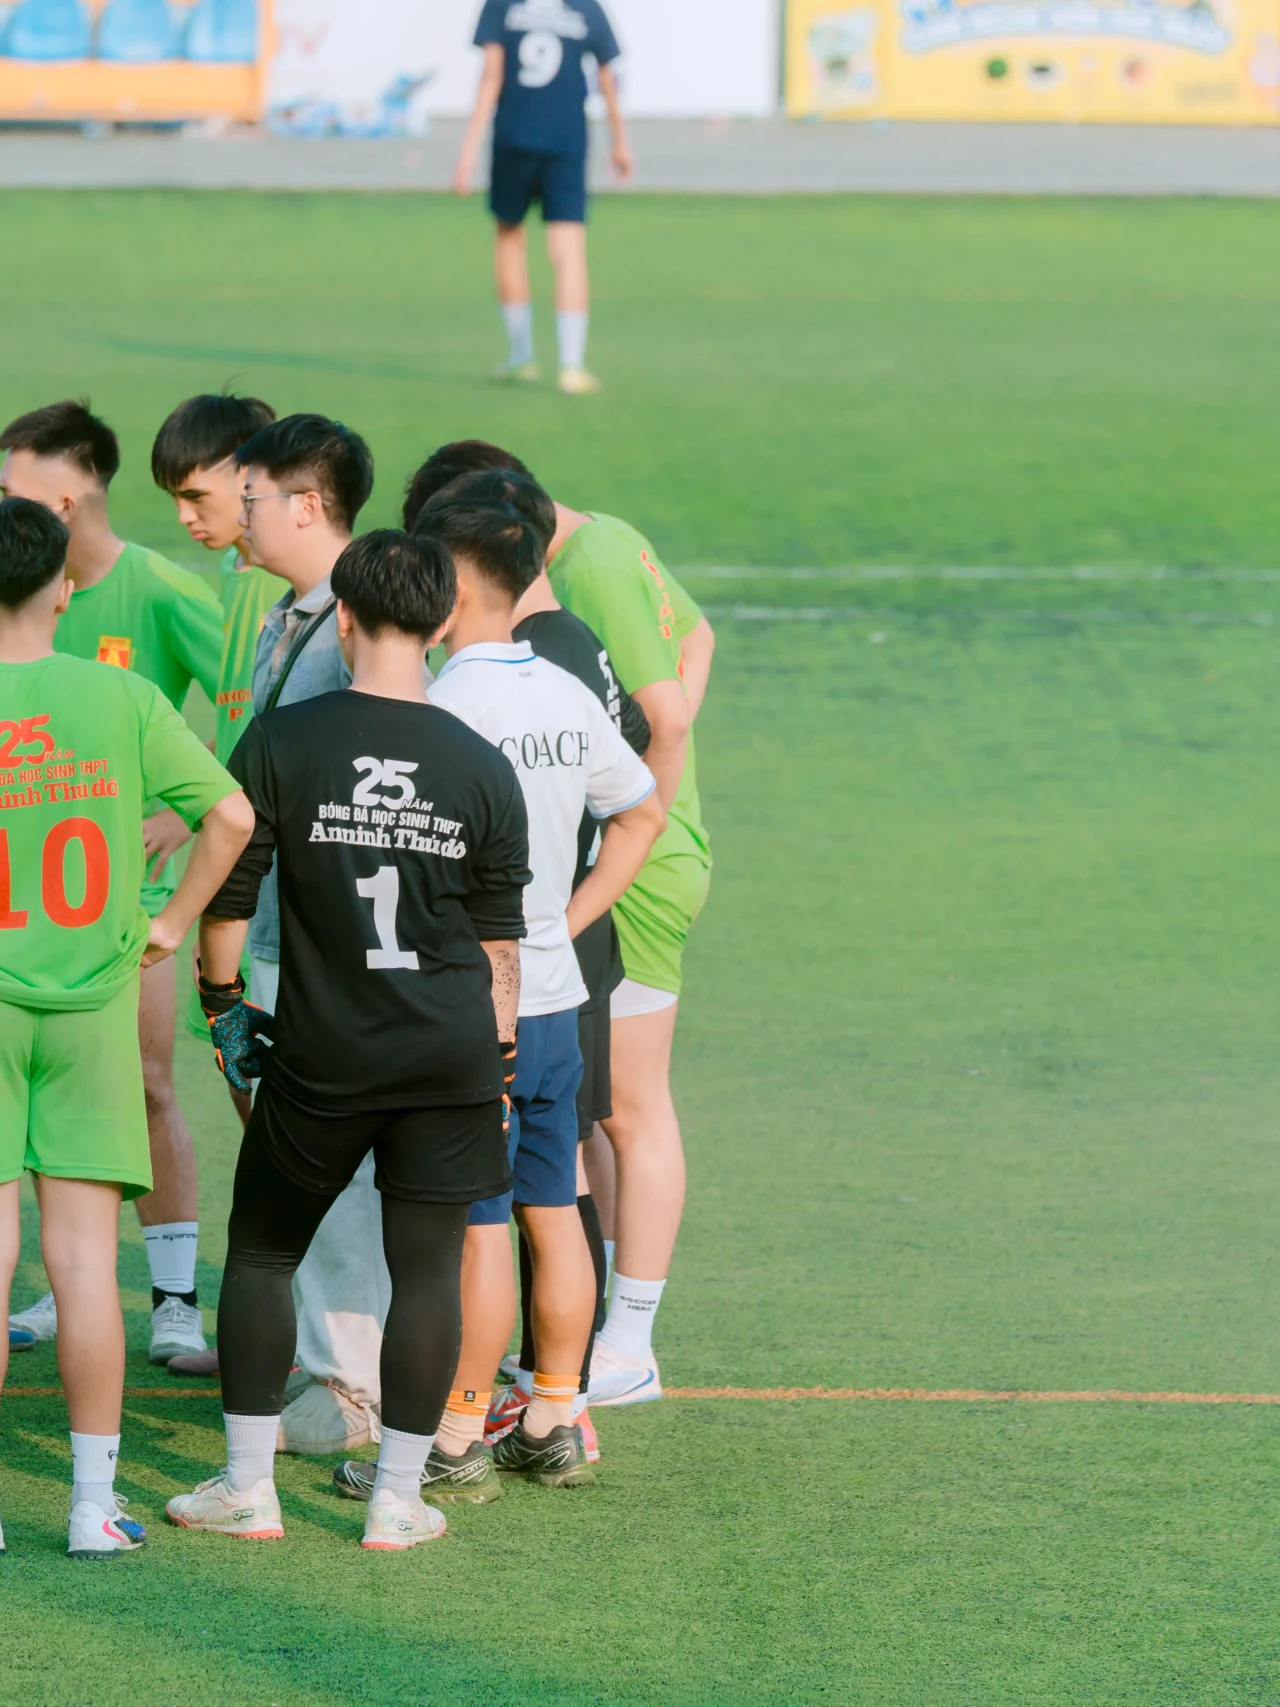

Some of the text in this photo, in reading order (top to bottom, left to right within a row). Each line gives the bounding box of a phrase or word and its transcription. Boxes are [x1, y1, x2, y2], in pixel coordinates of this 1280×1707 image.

[518, 29, 563, 88] 9
[46, 763, 76, 780] SINH
[79, 759, 109, 776] THPT
[500, 730, 589, 771] COACH
[352, 756, 419, 810] 25
[319, 801, 463, 837] BÓNG ĐÁ HỌC SINH THPT
[400, 798, 434, 811] NĂM
[356, 866, 420, 970] 1
